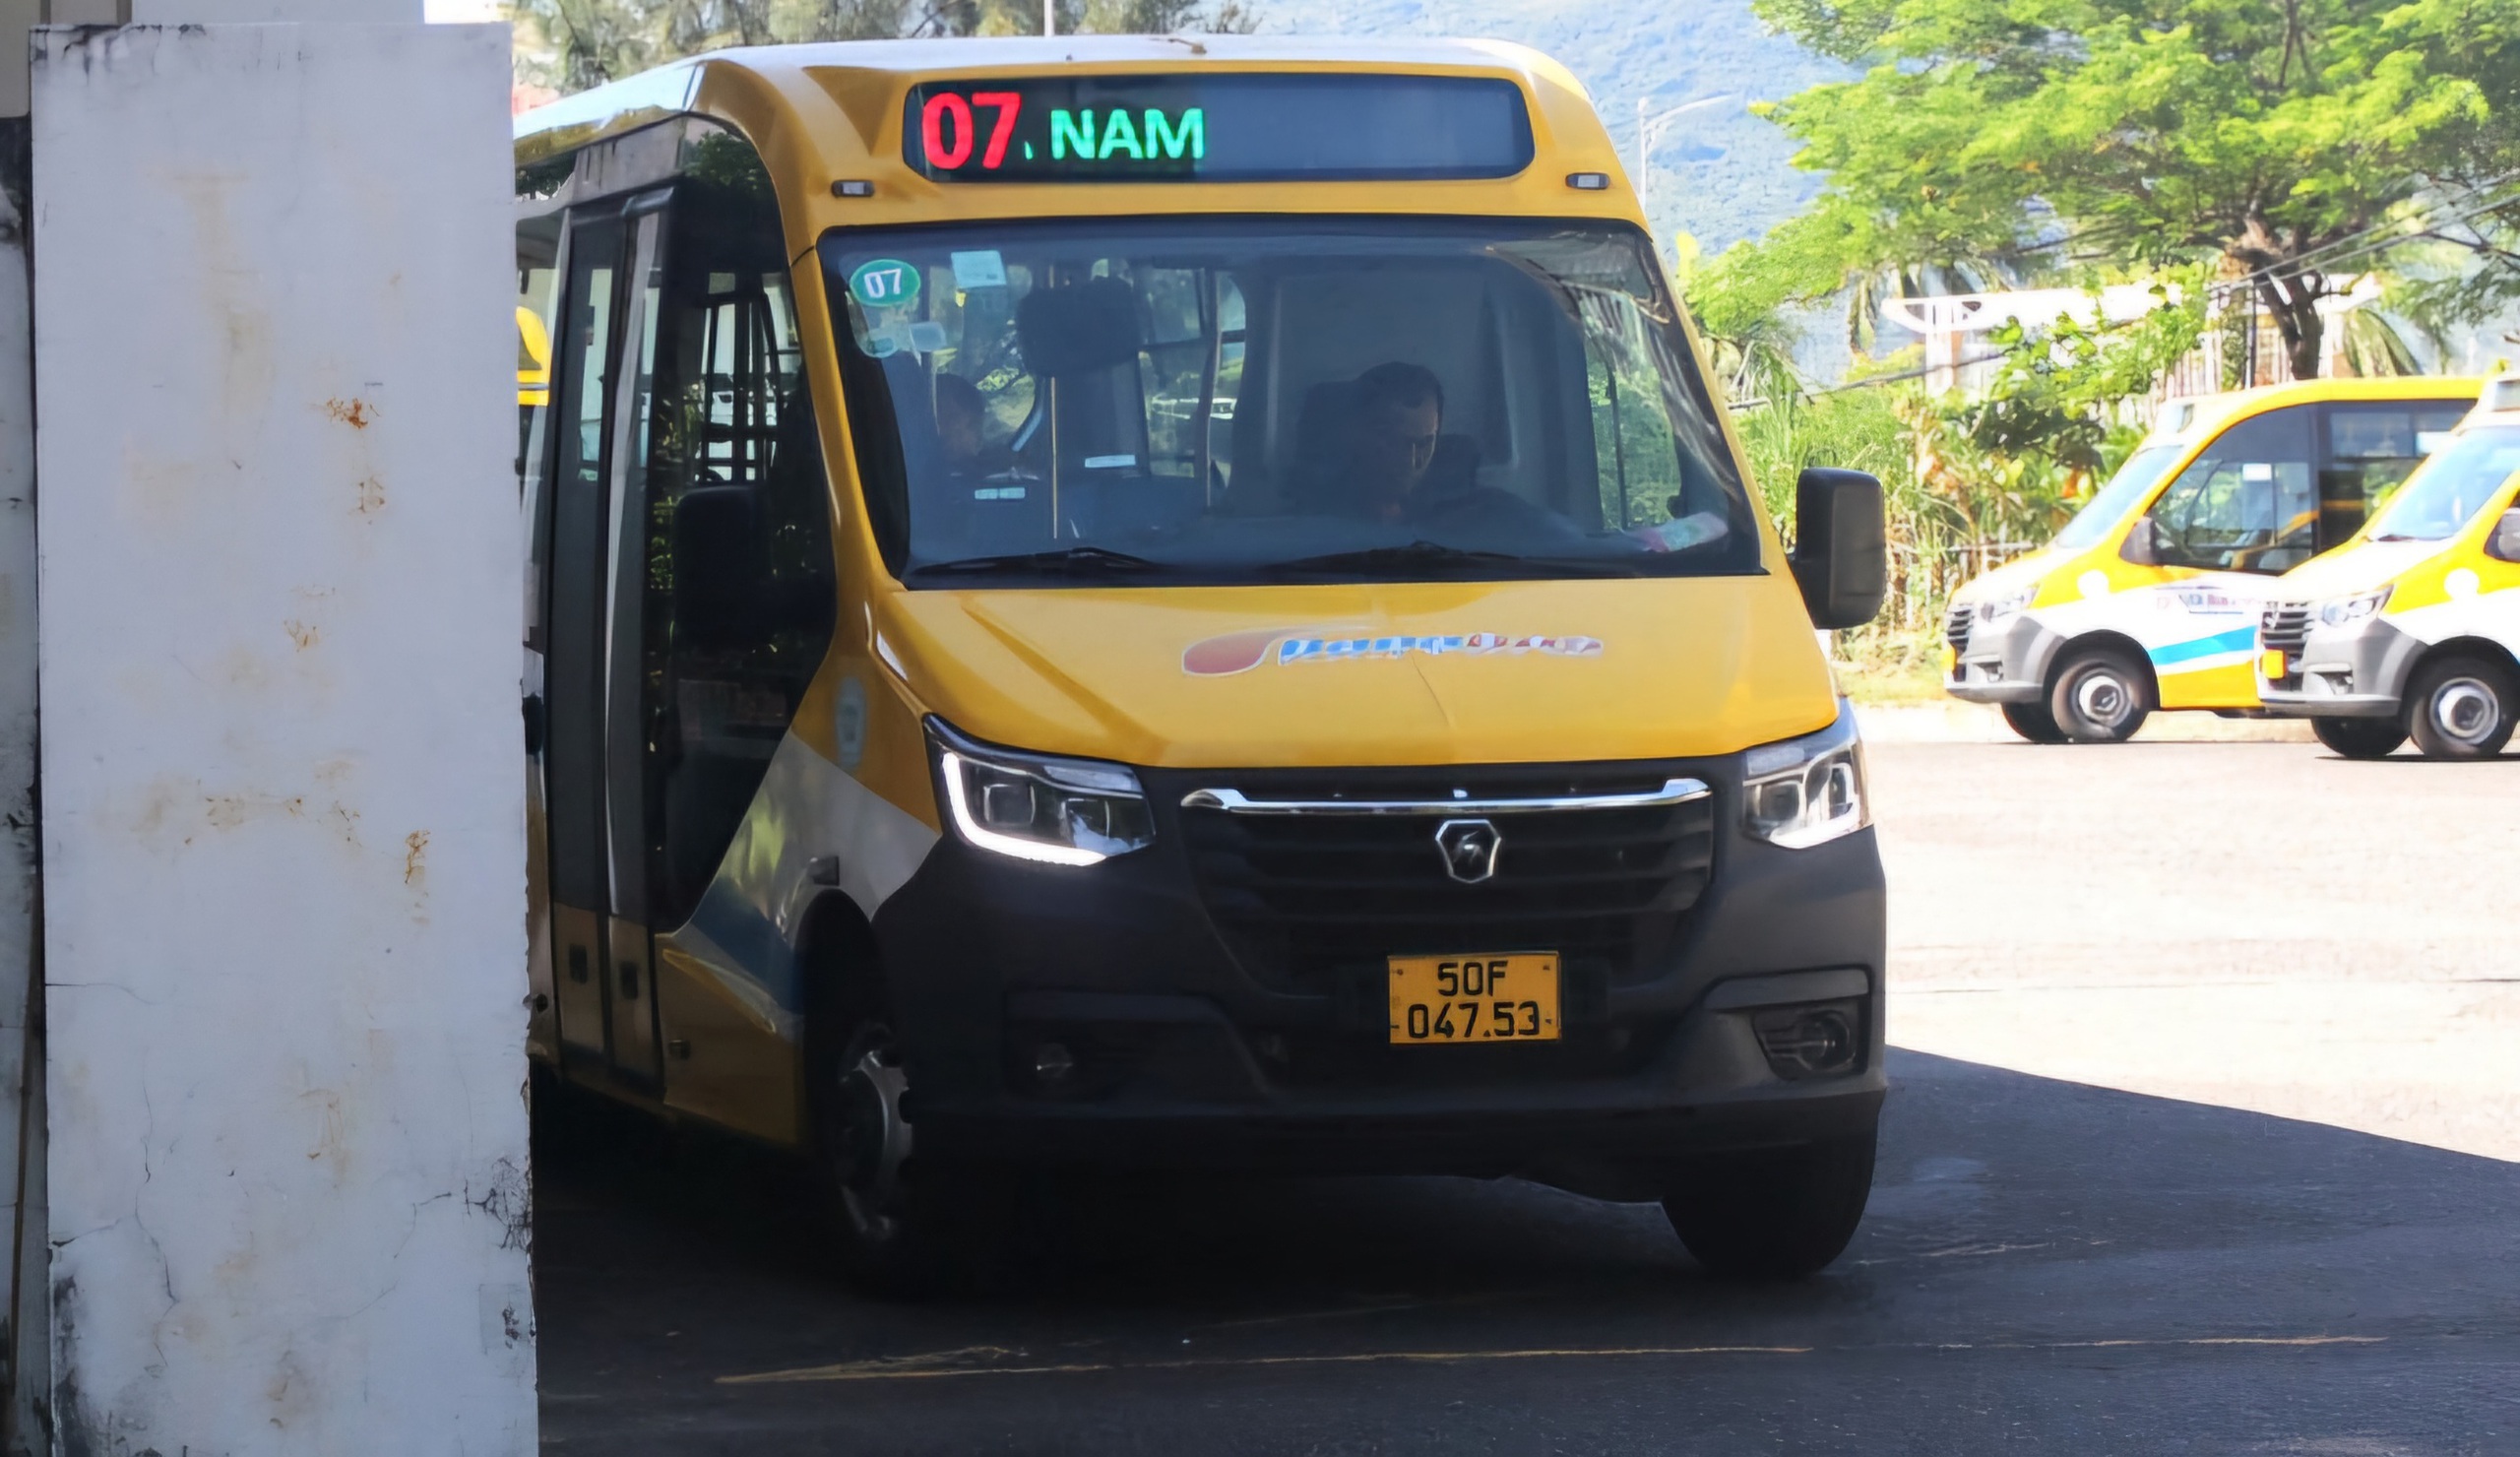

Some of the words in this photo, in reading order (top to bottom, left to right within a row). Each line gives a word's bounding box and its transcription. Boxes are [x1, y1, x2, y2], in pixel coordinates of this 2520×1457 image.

[921, 92, 1022, 169] 07
[1050, 108, 1205, 159] NAM
[863, 267, 902, 299] 07
[1437, 960, 1508, 997] 50F
[1408, 1000, 1541, 1039] 047.53
